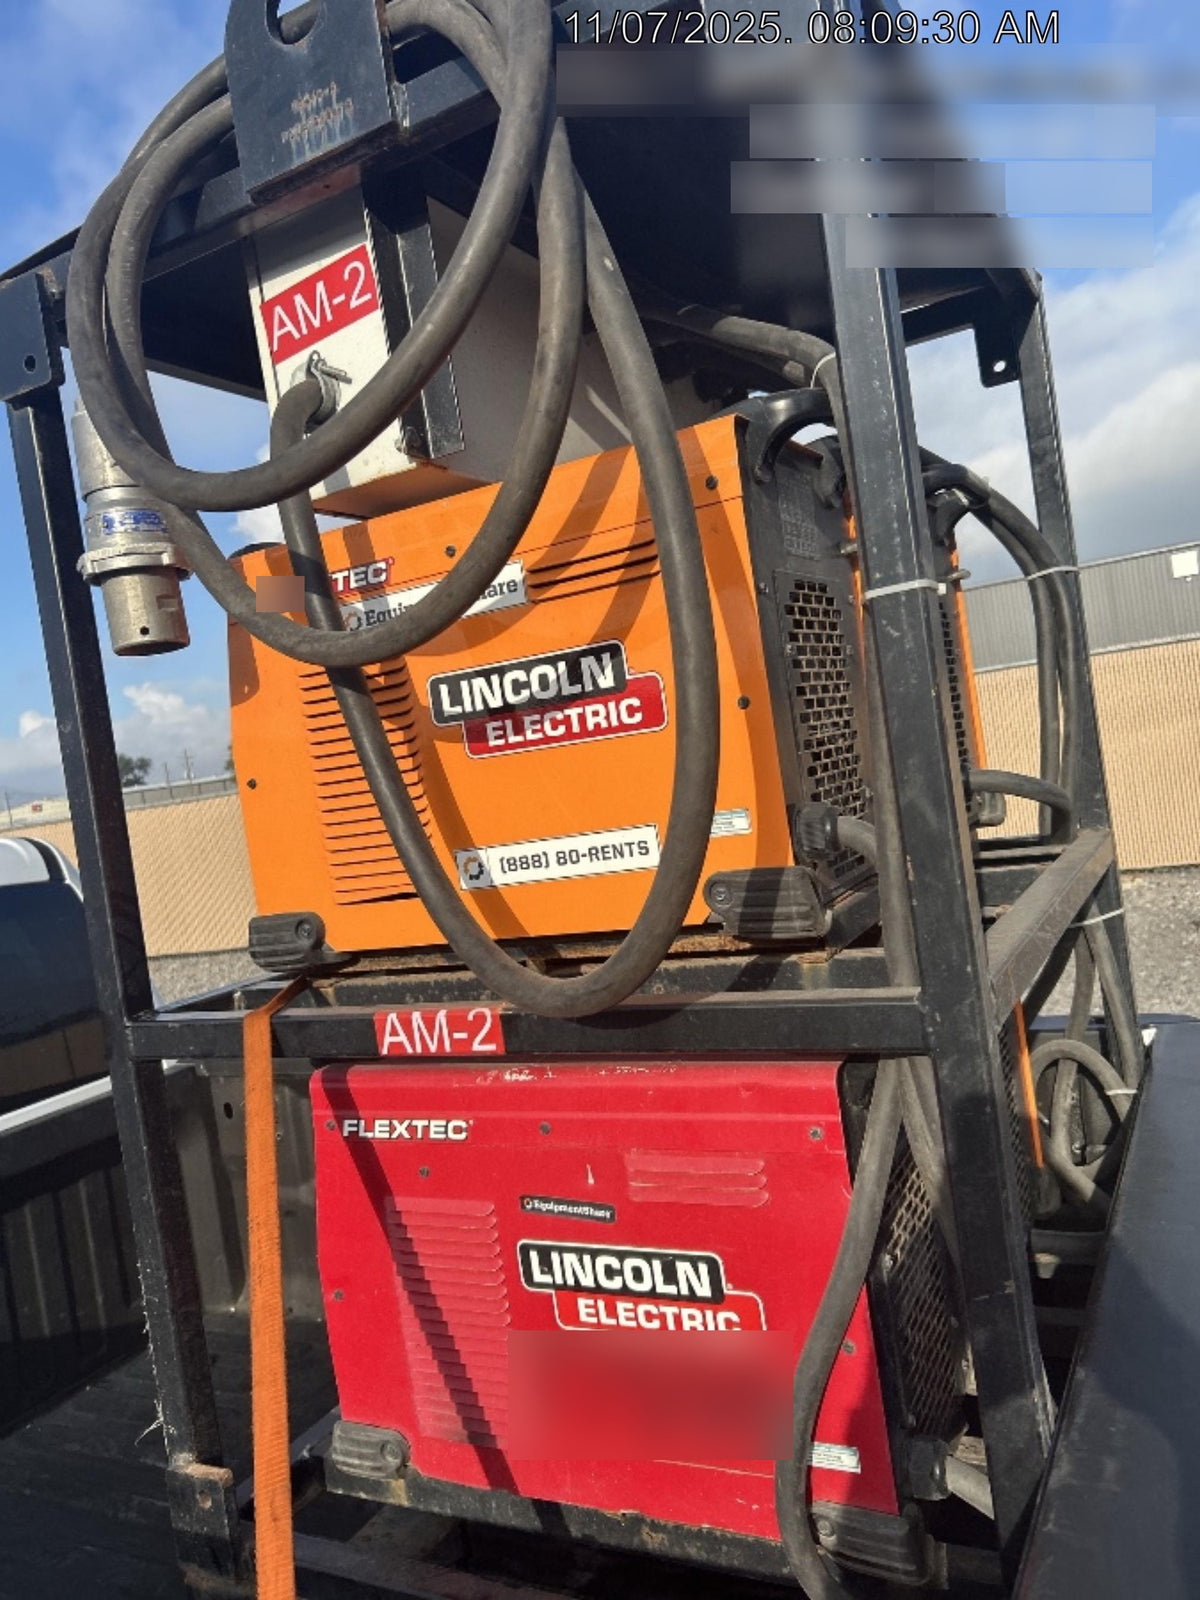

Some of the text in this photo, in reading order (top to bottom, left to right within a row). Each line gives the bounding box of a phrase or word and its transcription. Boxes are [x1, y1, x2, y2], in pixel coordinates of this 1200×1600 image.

[272, 260, 373, 353] AM-2
[438, 652, 615, 717] LINCOLN
[486, 697, 643, 747] ELECTRIC
[499, 840, 650, 874] (888) 80-RENTS
[381, 1007, 497, 1056] AM-2
[343, 1118, 469, 1140] FLEXTEC
[529, 1249, 713, 1298] LINCOLN
[577, 1297, 741, 1331] ELECTRIC
